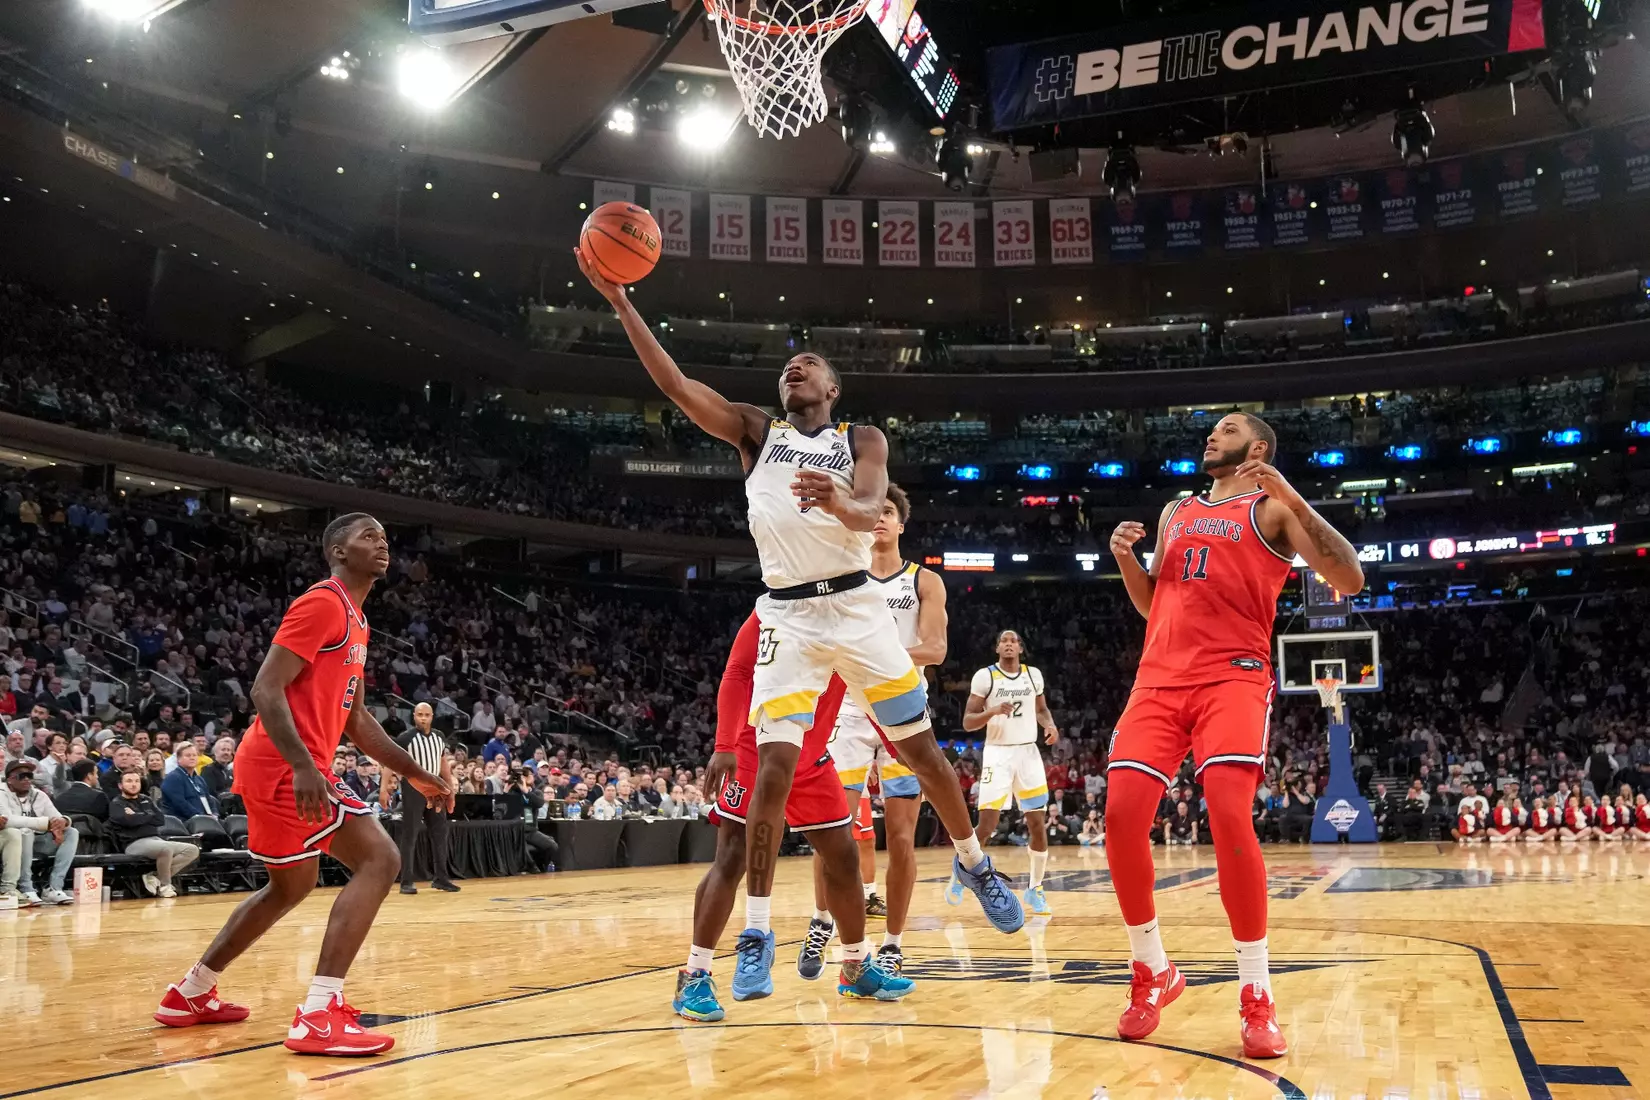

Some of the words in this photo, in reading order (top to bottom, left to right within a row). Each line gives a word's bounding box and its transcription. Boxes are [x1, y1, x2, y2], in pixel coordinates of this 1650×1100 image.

[64, 135, 117, 171] CHASE
[657, 207, 684, 235] 12
[716, 213, 744, 239] 15
[773, 216, 800, 242] 15
[829, 218, 856, 243] 19
[882, 220, 915, 245] 22
[938, 221, 971, 246] 24
[997, 219, 1030, 245] 33
[1052, 217, 1090, 242] 613
[620, 221, 657, 252] ELITE
[881, 249, 917, 261] KNICKS
[937, 250, 973, 262] KNICKS
[996, 249, 1033, 261] KNICKS
[627, 462, 649, 472] BUD
[650, 464, 681, 473] LIGHT
[684, 465, 713, 475] BLUE
[765, 444, 851, 471] Marquette
[1186, 518, 1243, 542] JOHN'S
[1181, 546, 1210, 582] 11
[816, 580, 834, 595] RL
